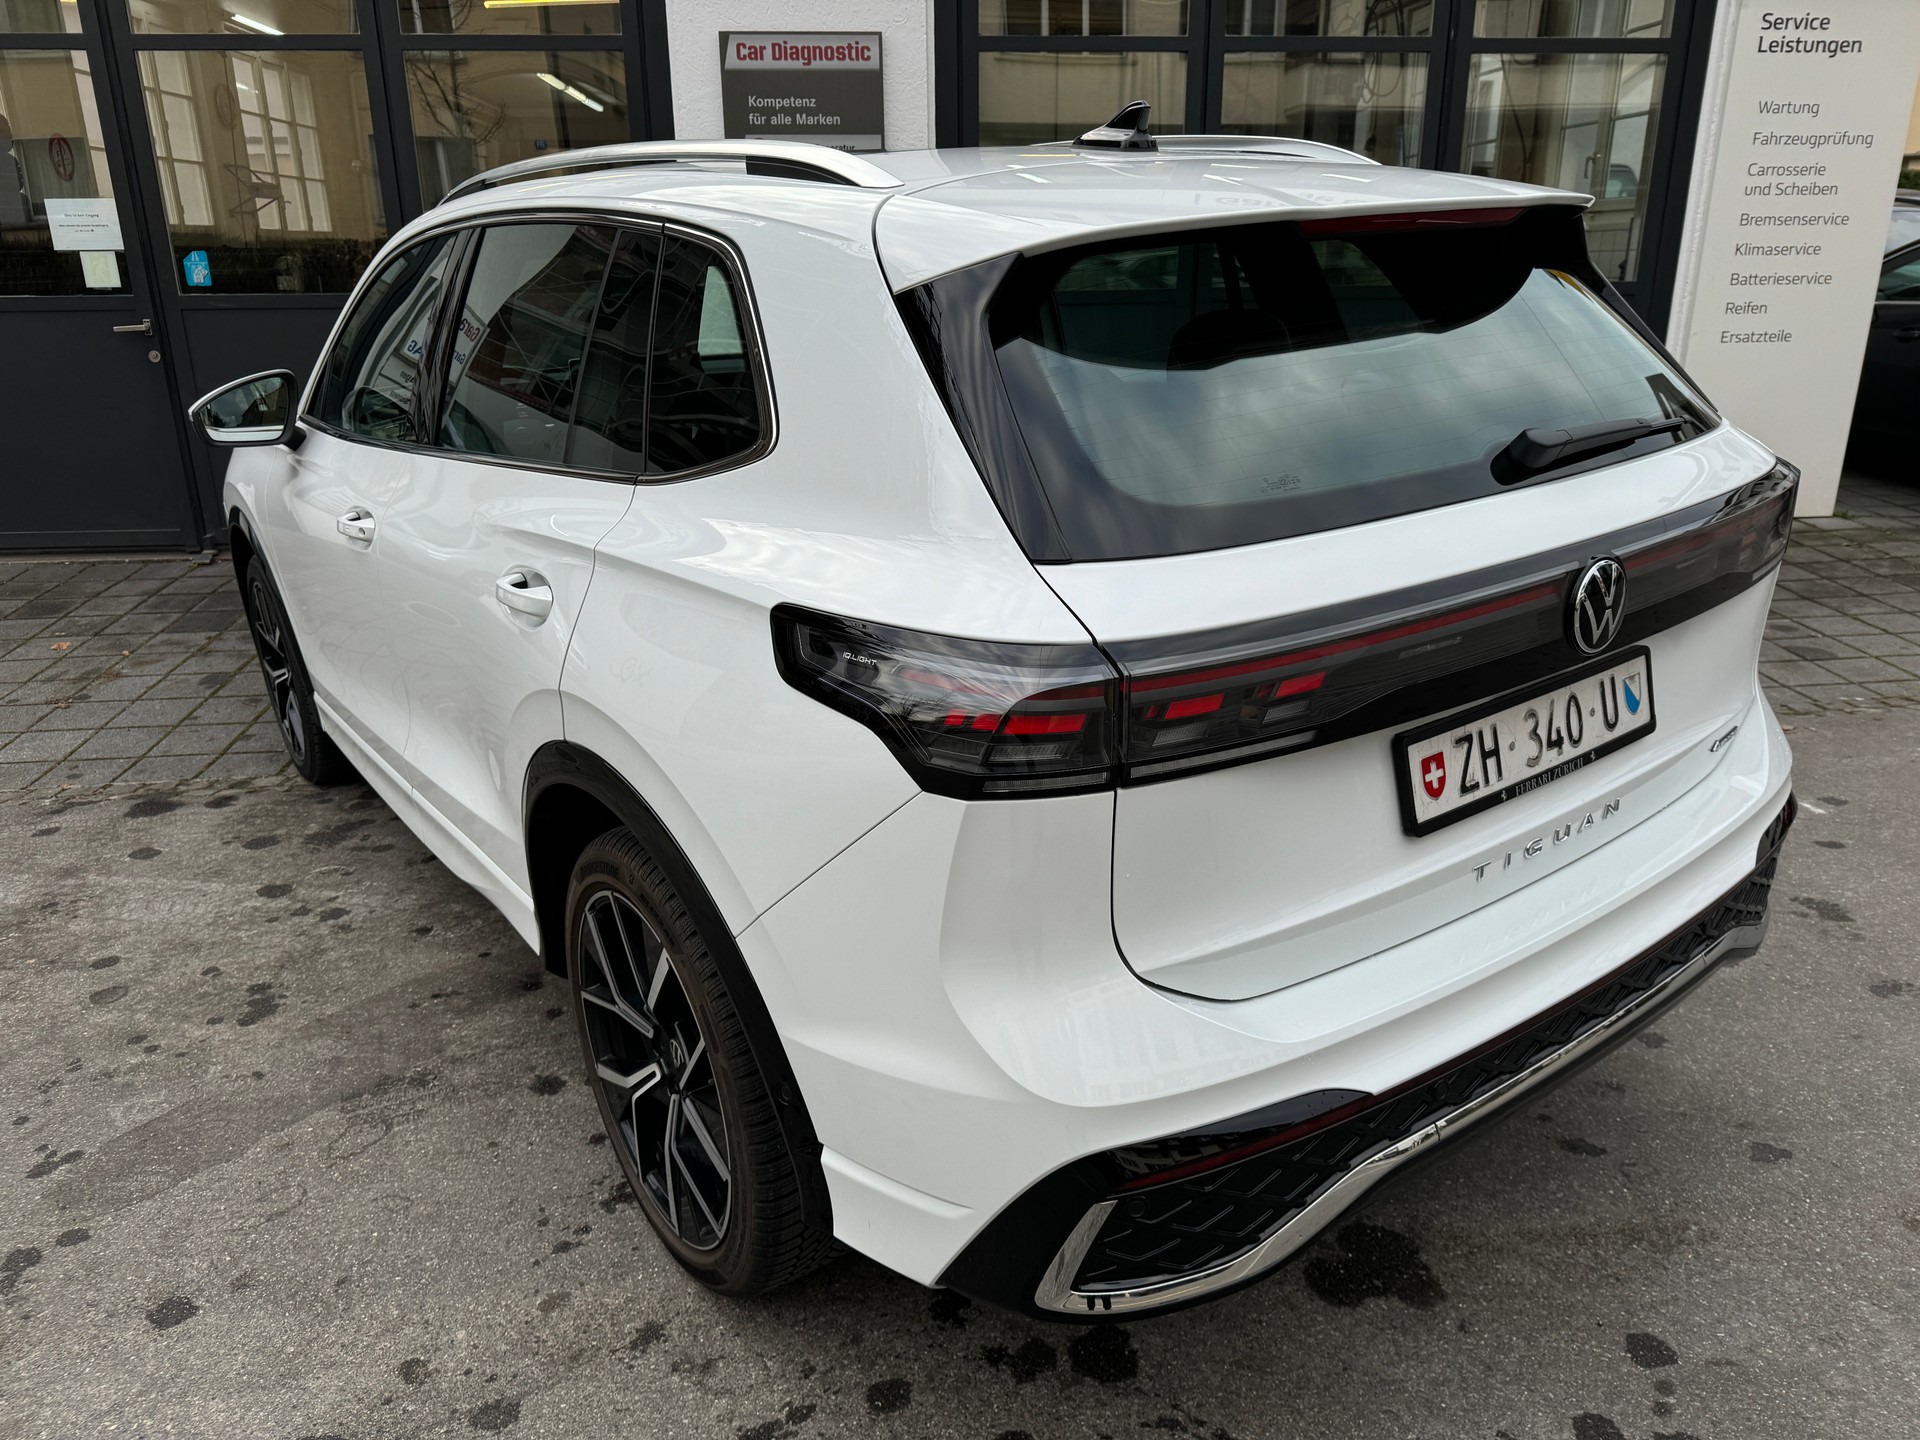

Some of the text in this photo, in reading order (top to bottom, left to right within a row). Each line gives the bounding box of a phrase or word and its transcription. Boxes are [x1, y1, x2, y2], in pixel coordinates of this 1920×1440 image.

[1761, 12, 1831, 31] Service
[735, 40, 872, 67] Car Diagnostic
[1757, 35, 1863, 58] Leistungen
[748, 95, 817, 110] Kompetenz
[1758, 100, 1820, 118] Wartung
[748, 113, 841, 125] für alle Marken
[1752, 131, 1874, 149] Fahrzeugprüfung
[1747, 162, 1827, 177] Carrosserie
[1744, 182, 1839, 197] und Scheiben
[1739, 212, 1850, 227] Bremsenservice
[1734, 243, 1822, 256] Klimaservice
[1729, 271, 1833, 286] Batterieservice
[1724, 301, 1768, 315] Reifen
[1720, 330, 1793, 344] Ersatzteile
[1515, 757, 1584, 796] FERRARI ZÜRICH
[1472, 797, 1621, 882] TIGUAN
